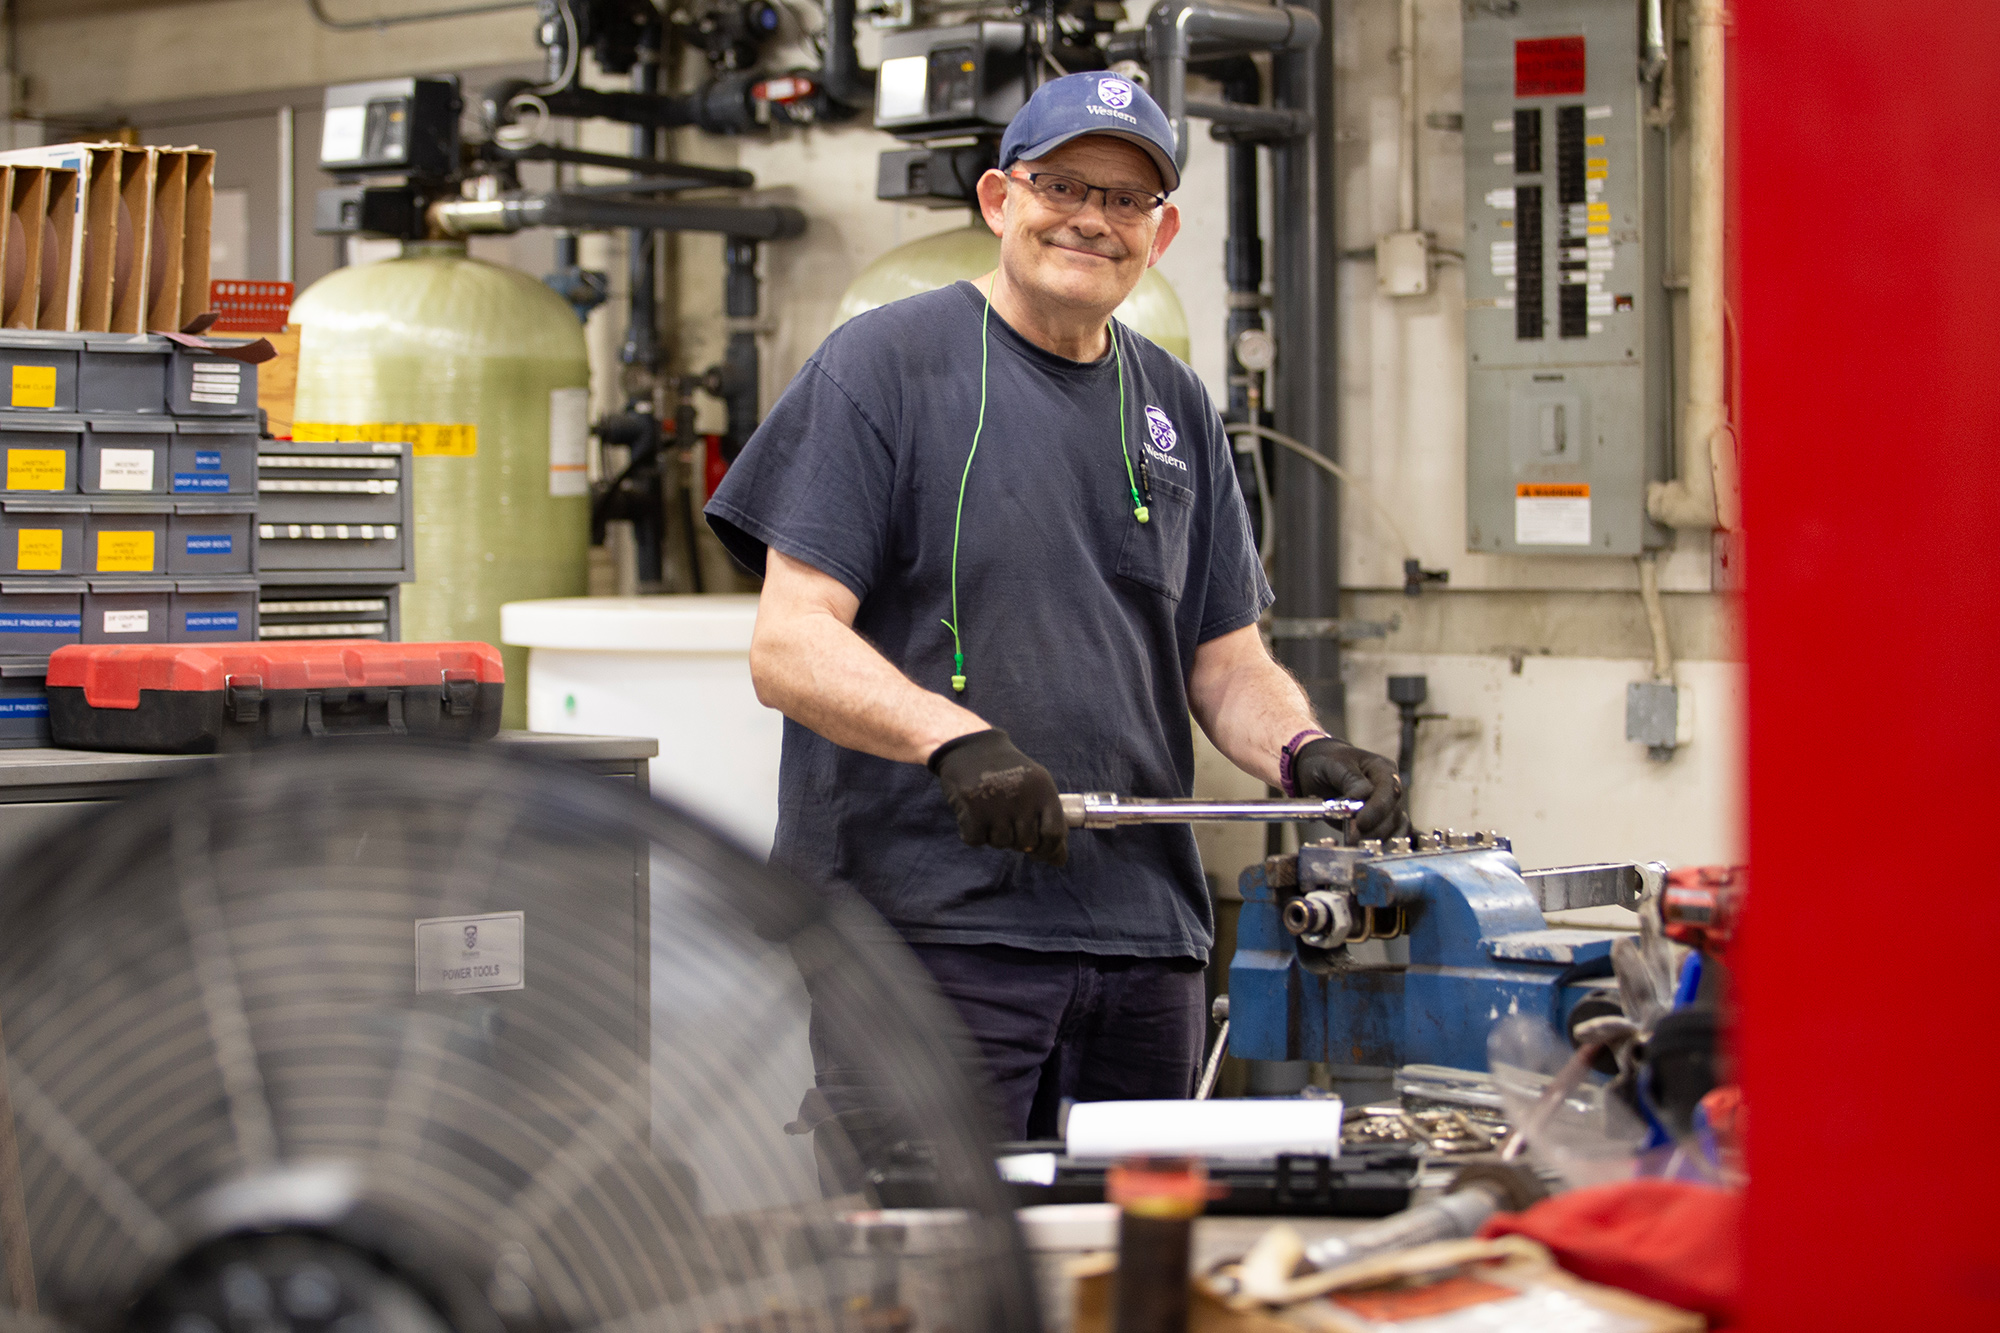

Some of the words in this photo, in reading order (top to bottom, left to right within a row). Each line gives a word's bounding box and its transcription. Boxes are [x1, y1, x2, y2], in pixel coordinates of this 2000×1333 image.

[1085, 104, 1138, 126] Western
[1143, 442, 1188, 471] Western
[186, 540, 211, 549] ANCHOR
[212, 540, 232, 549] BOLTS
[186, 617, 211, 626] ANCHOR
[212, 617, 238, 625] SCREWS
[442, 966, 473, 981] POWER
[473, 964, 500, 978] TOOLS
